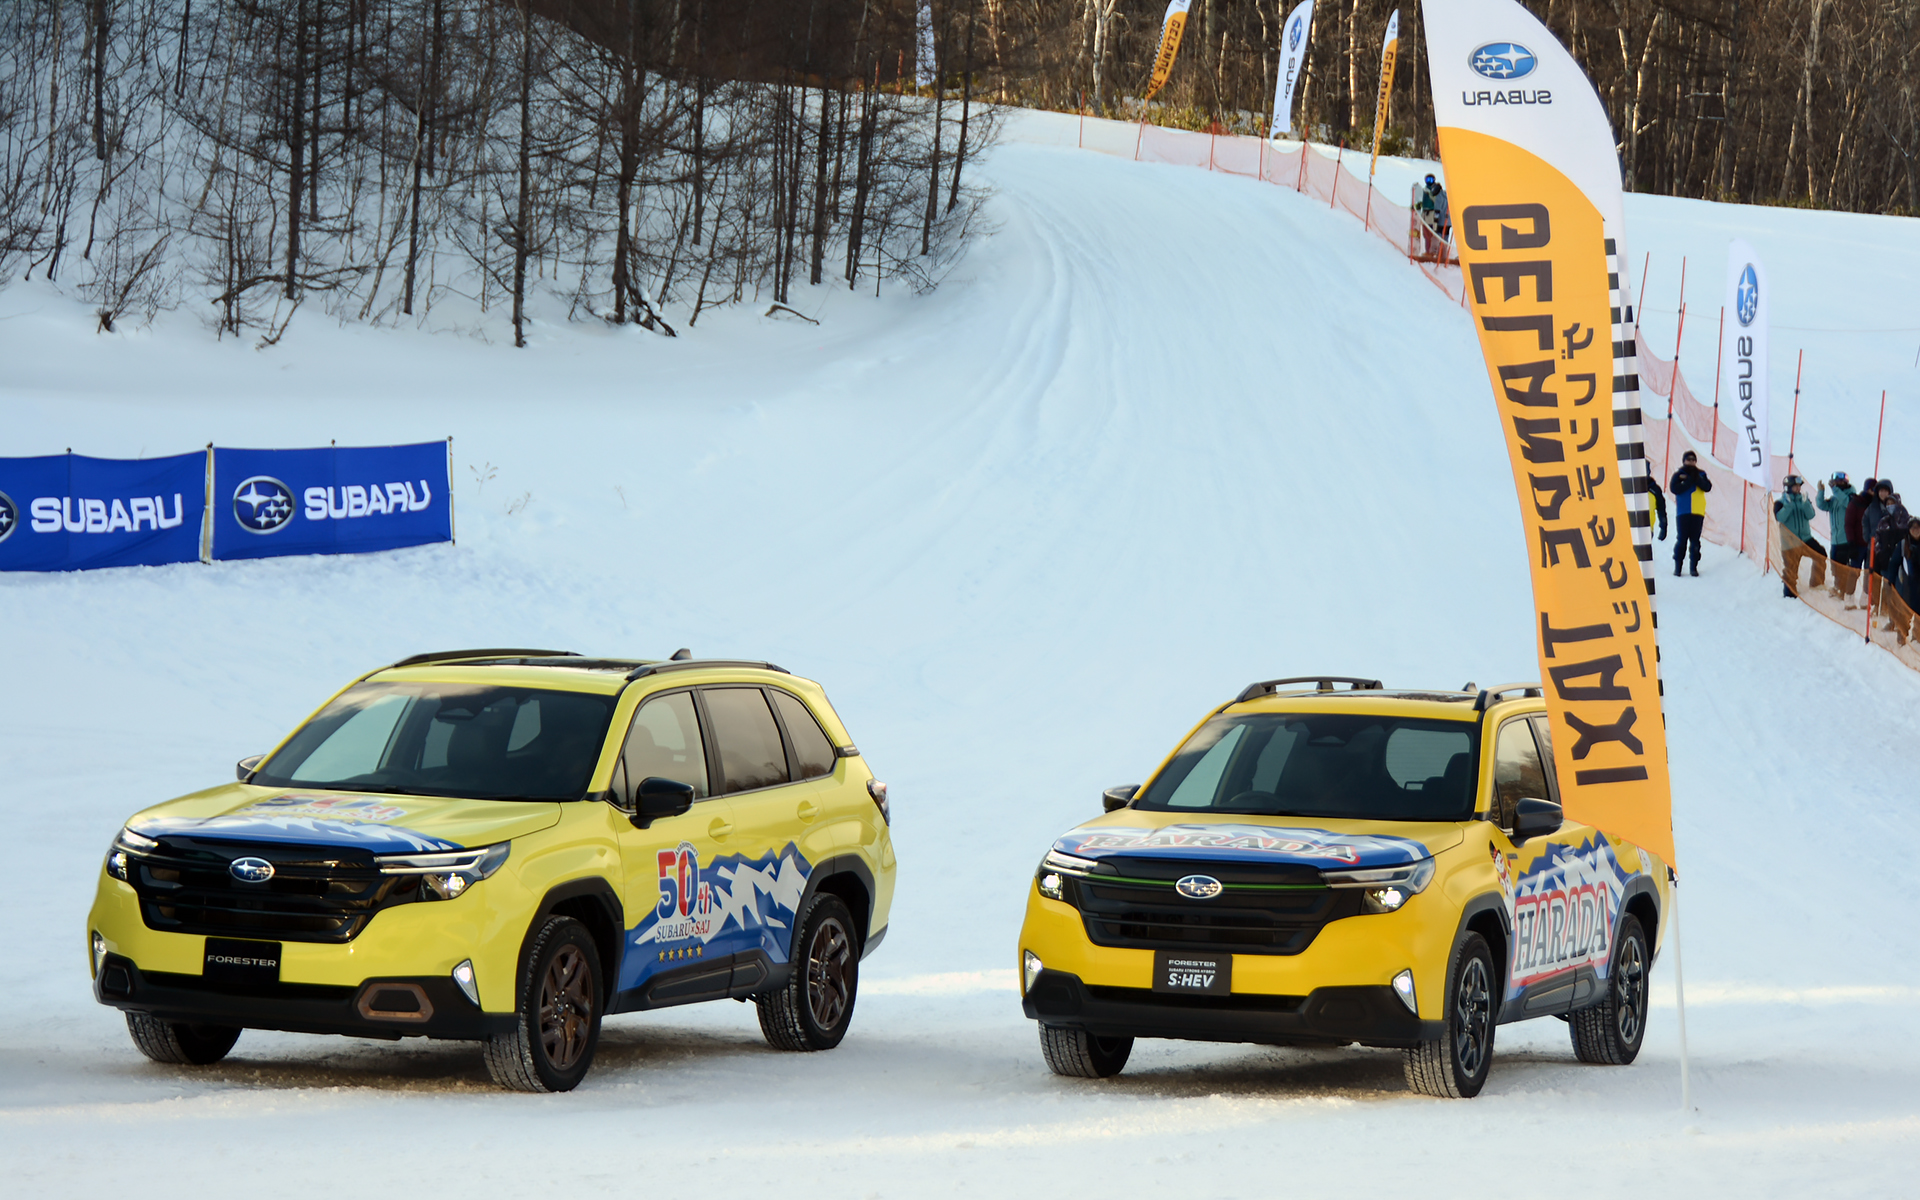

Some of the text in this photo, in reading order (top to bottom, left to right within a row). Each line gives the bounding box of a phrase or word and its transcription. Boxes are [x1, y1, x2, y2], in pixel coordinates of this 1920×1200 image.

[1272, 56, 1296, 129] SUBU
[30, 492, 183, 534] SUBARU
[303, 479, 432, 521] SUBARU
[1079, 834, 1358, 863] HARADA
[658, 849, 714, 919] 50th
[1512, 891, 1609, 977] HARADA
[207, 954, 277, 967] FORESTER
[1168, 959, 1216, 967] FORESTER
[1168, 973, 1214, 987] S:HEV
